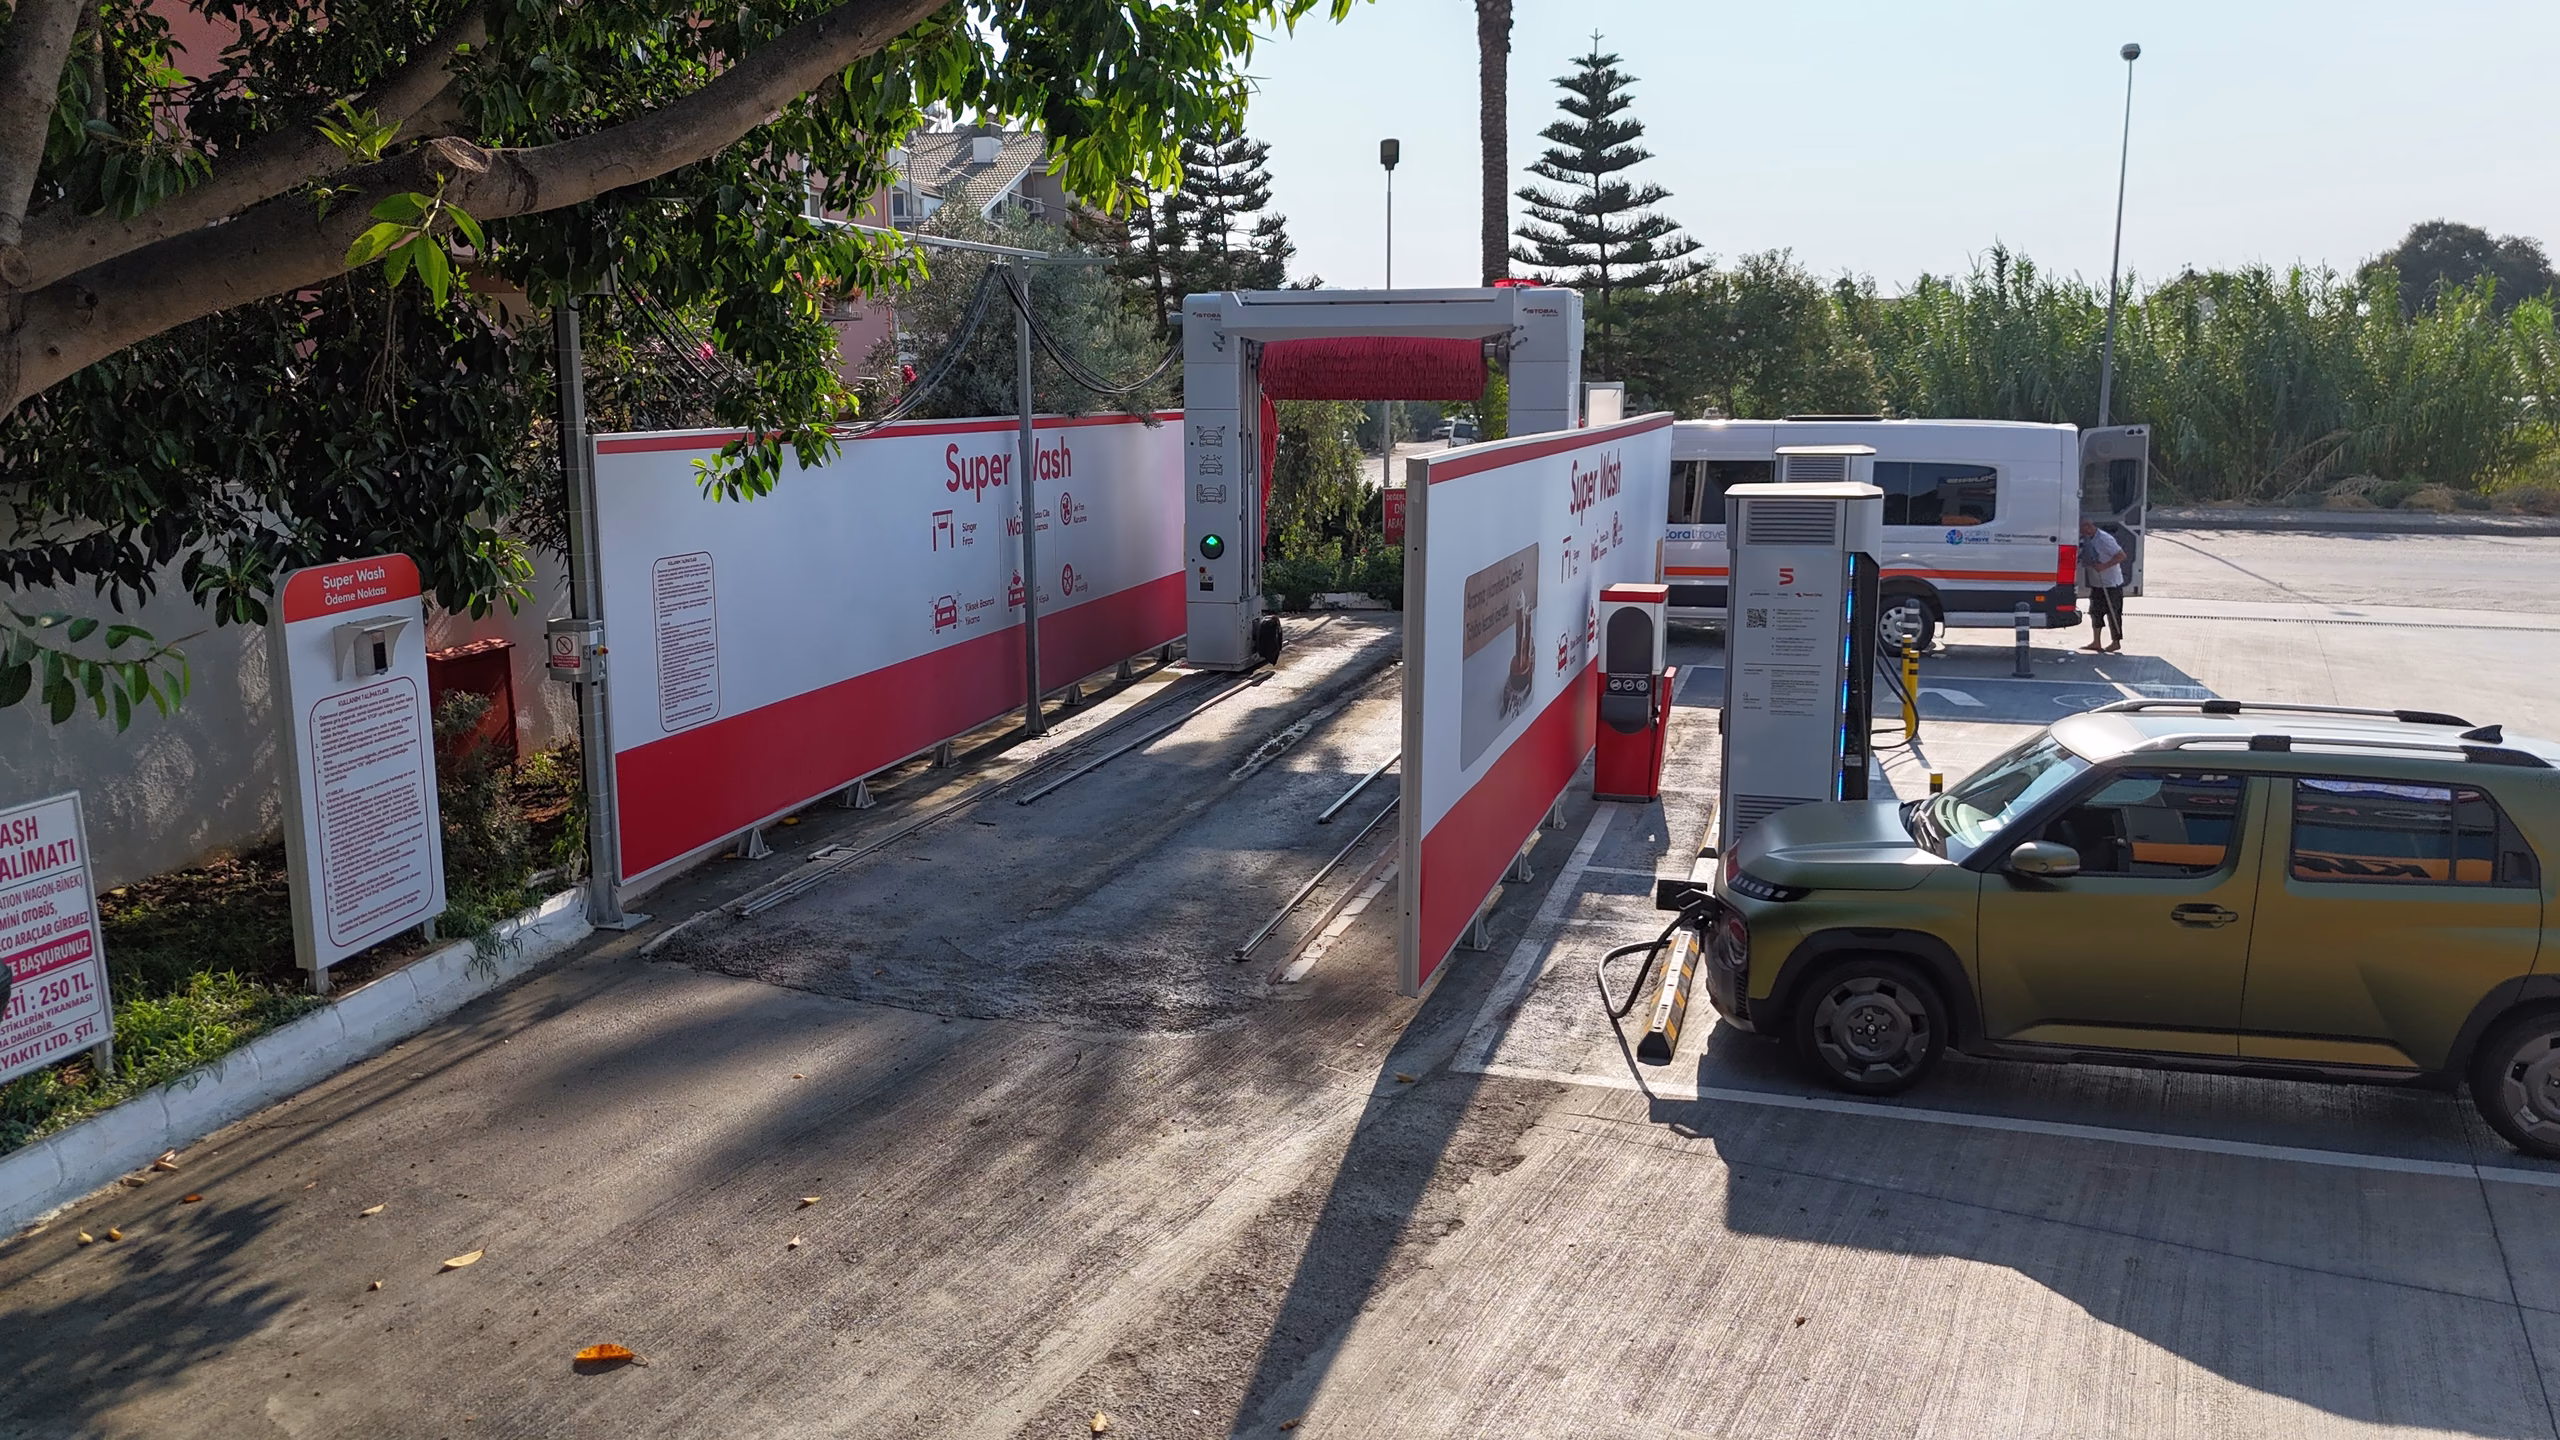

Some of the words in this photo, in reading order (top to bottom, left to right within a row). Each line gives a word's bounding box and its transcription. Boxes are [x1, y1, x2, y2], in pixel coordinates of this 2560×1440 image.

[945, 443, 1012, 503] Super
[1570, 459, 1598, 526] Super
[1600, 449, 1621, 501] Wash
[1665, 529, 1727, 540] oraltrave
[323, 574, 354, 590] Super
[356, 566, 385, 582] Wash
[325, 592, 356, 606] Ödeme
[357, 587, 387, 599] Noktası
[0, 815, 38, 849] ASH
[0, 838, 76, 883] ALİMATI
[0, 893, 22, 911] ATION
[0, 936, 13, 952] CO
[15, 923, 54, 946] ARAÇLAR
[54, 911, 89, 933] GİREMEZ
[19, 937, 90, 974] BAŞVURUNUZ
[0, 1011, 45, 1036] STİKLERİN
[45, 993, 93, 1017] YIKANMASI
[3, 988, 26, 1020] ETİ
[39, 978, 70, 1007] 250
[72, 971, 94, 993] TL.
[0, 1042, 41, 1072] YAKIT
[44, 1029, 72, 1053] LTD.
[74, 1017, 98, 1042] ŞTİ.
[10, 1021, 56, 1044] DAHİLDİR.
